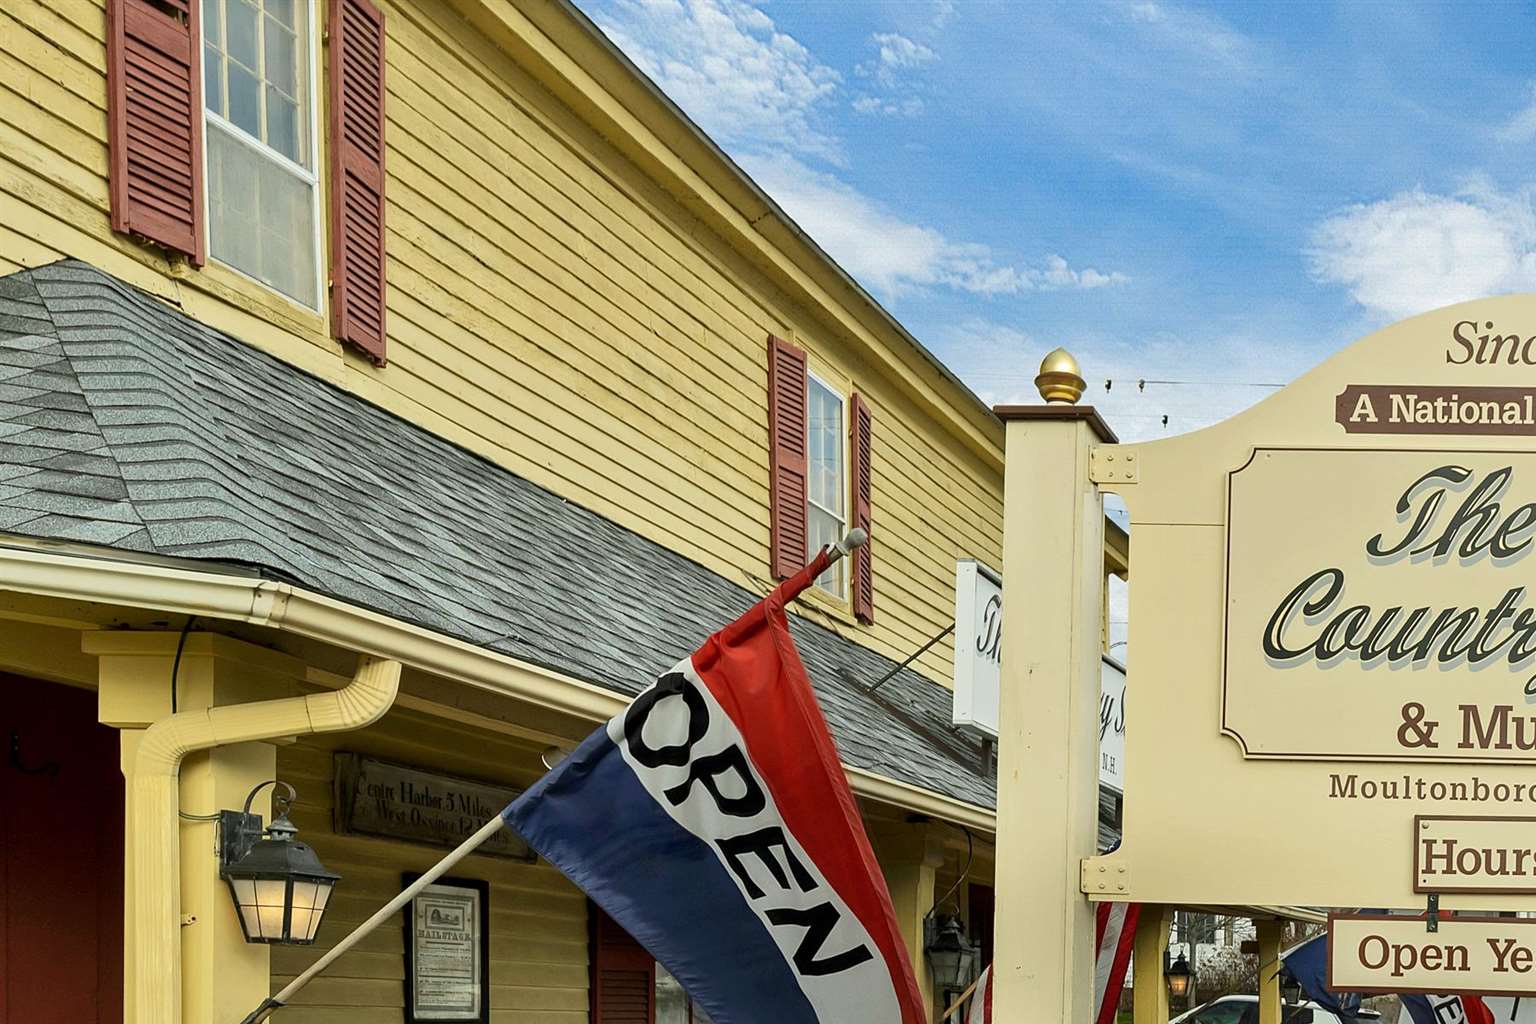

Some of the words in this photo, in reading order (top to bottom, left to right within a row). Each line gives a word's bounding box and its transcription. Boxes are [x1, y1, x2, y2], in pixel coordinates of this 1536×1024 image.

[1349, 393, 1379, 424] A
[1388, 393, 1535, 426] National
[976, 594, 1001, 664] Th
[1396, 701, 1439, 750] &
[1102, 752, 1118, 776] N.H.
[624, 672, 873, 976] OPEN
[1358, 935, 1472, 978] Open
